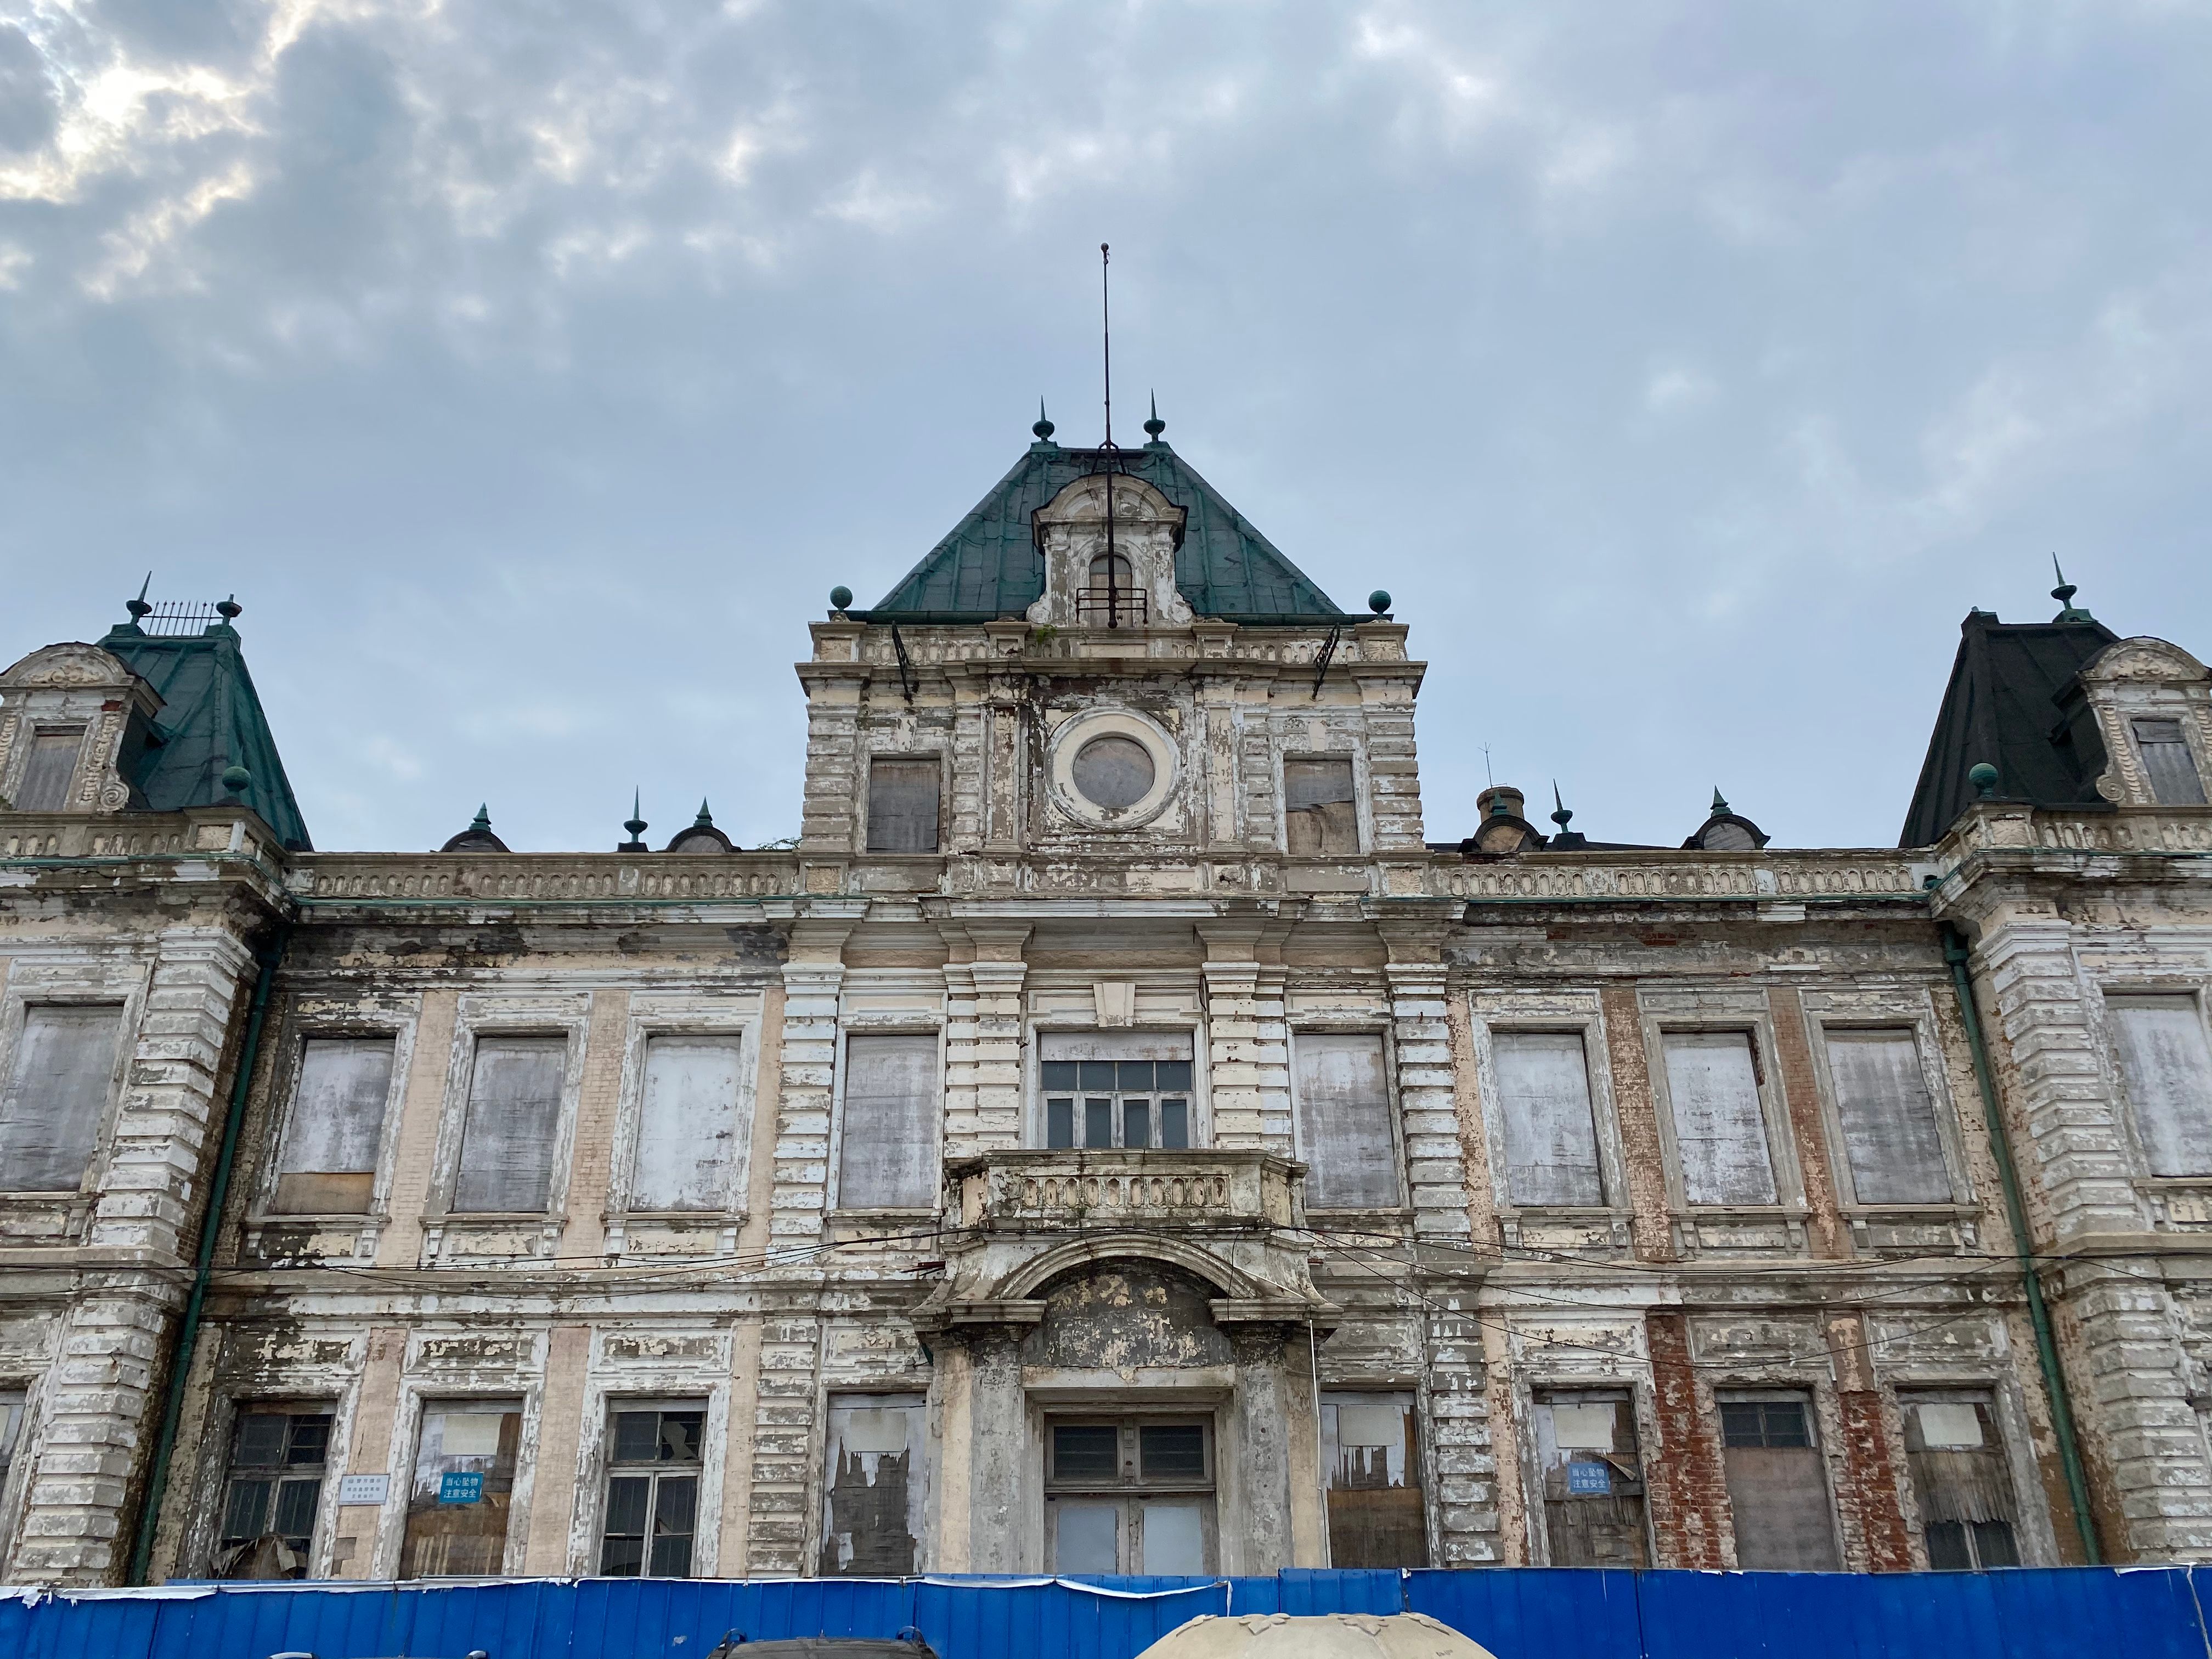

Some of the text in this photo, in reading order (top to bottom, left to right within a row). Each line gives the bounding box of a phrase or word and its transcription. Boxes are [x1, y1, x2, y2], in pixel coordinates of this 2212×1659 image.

[1572, 1468, 1605, 1477] 当心坠物
[445, 1477, 479, 1486] 当心坠物
[1573, 1479, 1606, 1488] 注意安全
[443, 1488, 477, 1498] 注意安全
